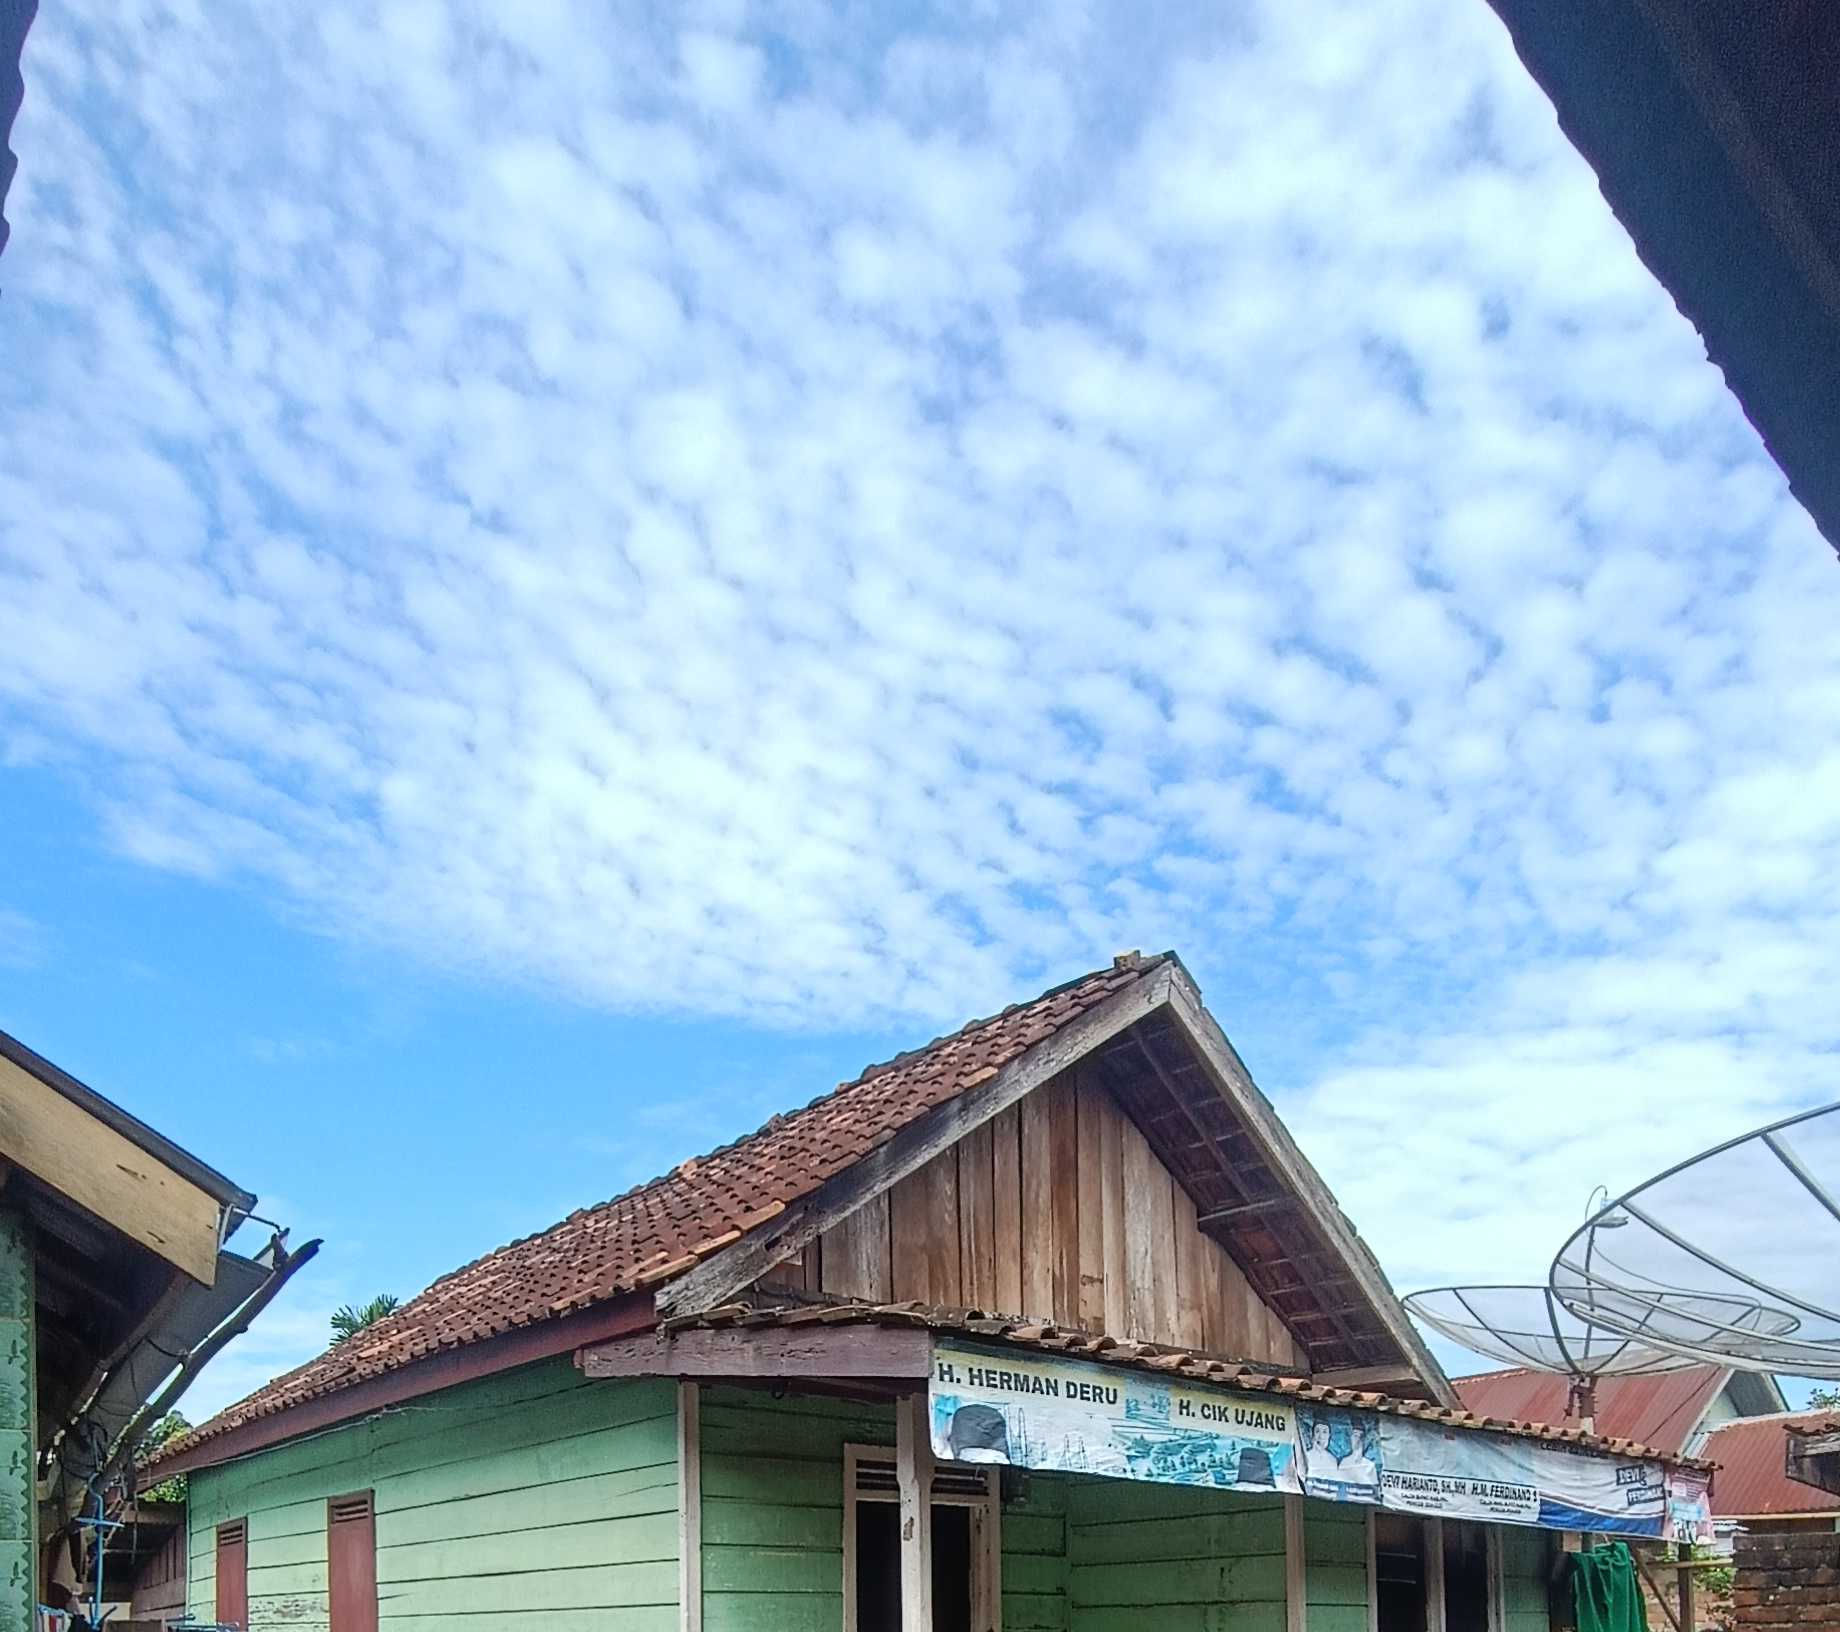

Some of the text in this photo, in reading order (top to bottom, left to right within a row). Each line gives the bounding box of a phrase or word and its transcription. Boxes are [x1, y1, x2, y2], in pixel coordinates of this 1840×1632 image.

[937, 1361, 1119, 1405] H. HERMAN DERU
[1177, 1398, 1286, 1432] H. CIK UJANG
